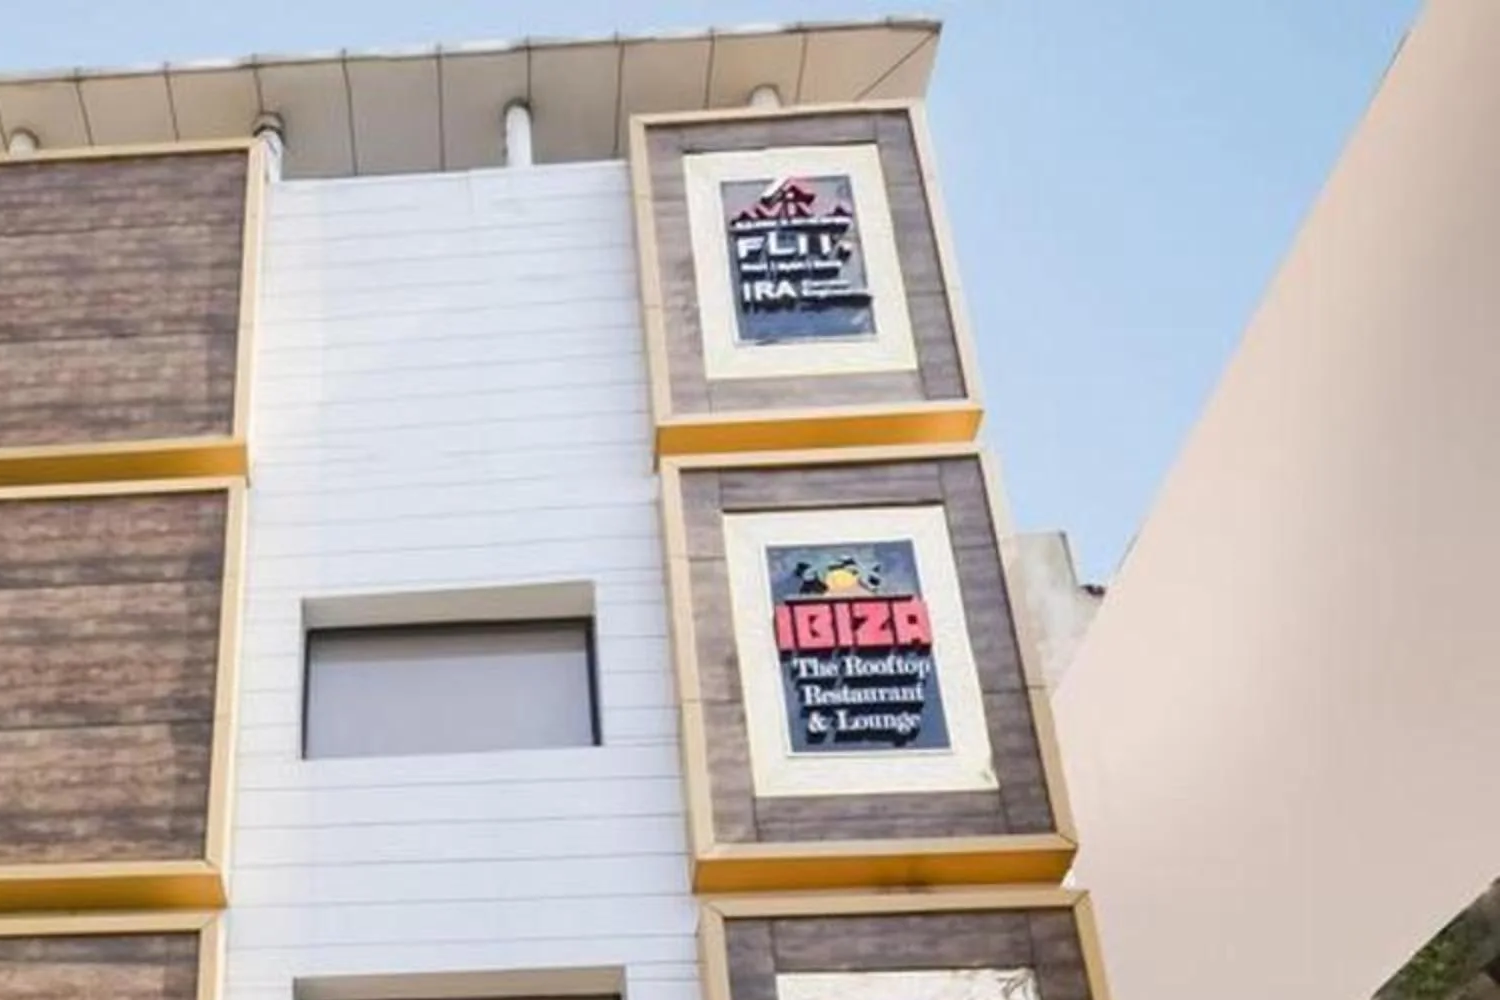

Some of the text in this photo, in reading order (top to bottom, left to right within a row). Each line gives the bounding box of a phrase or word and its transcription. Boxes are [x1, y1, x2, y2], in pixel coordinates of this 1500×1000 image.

[774, 598, 932, 650] IBIZA
[792, 654, 931, 679] The Rooftop
[802, 682, 925, 706] Restaurant
[808, 709, 921, 733] & Lounge
